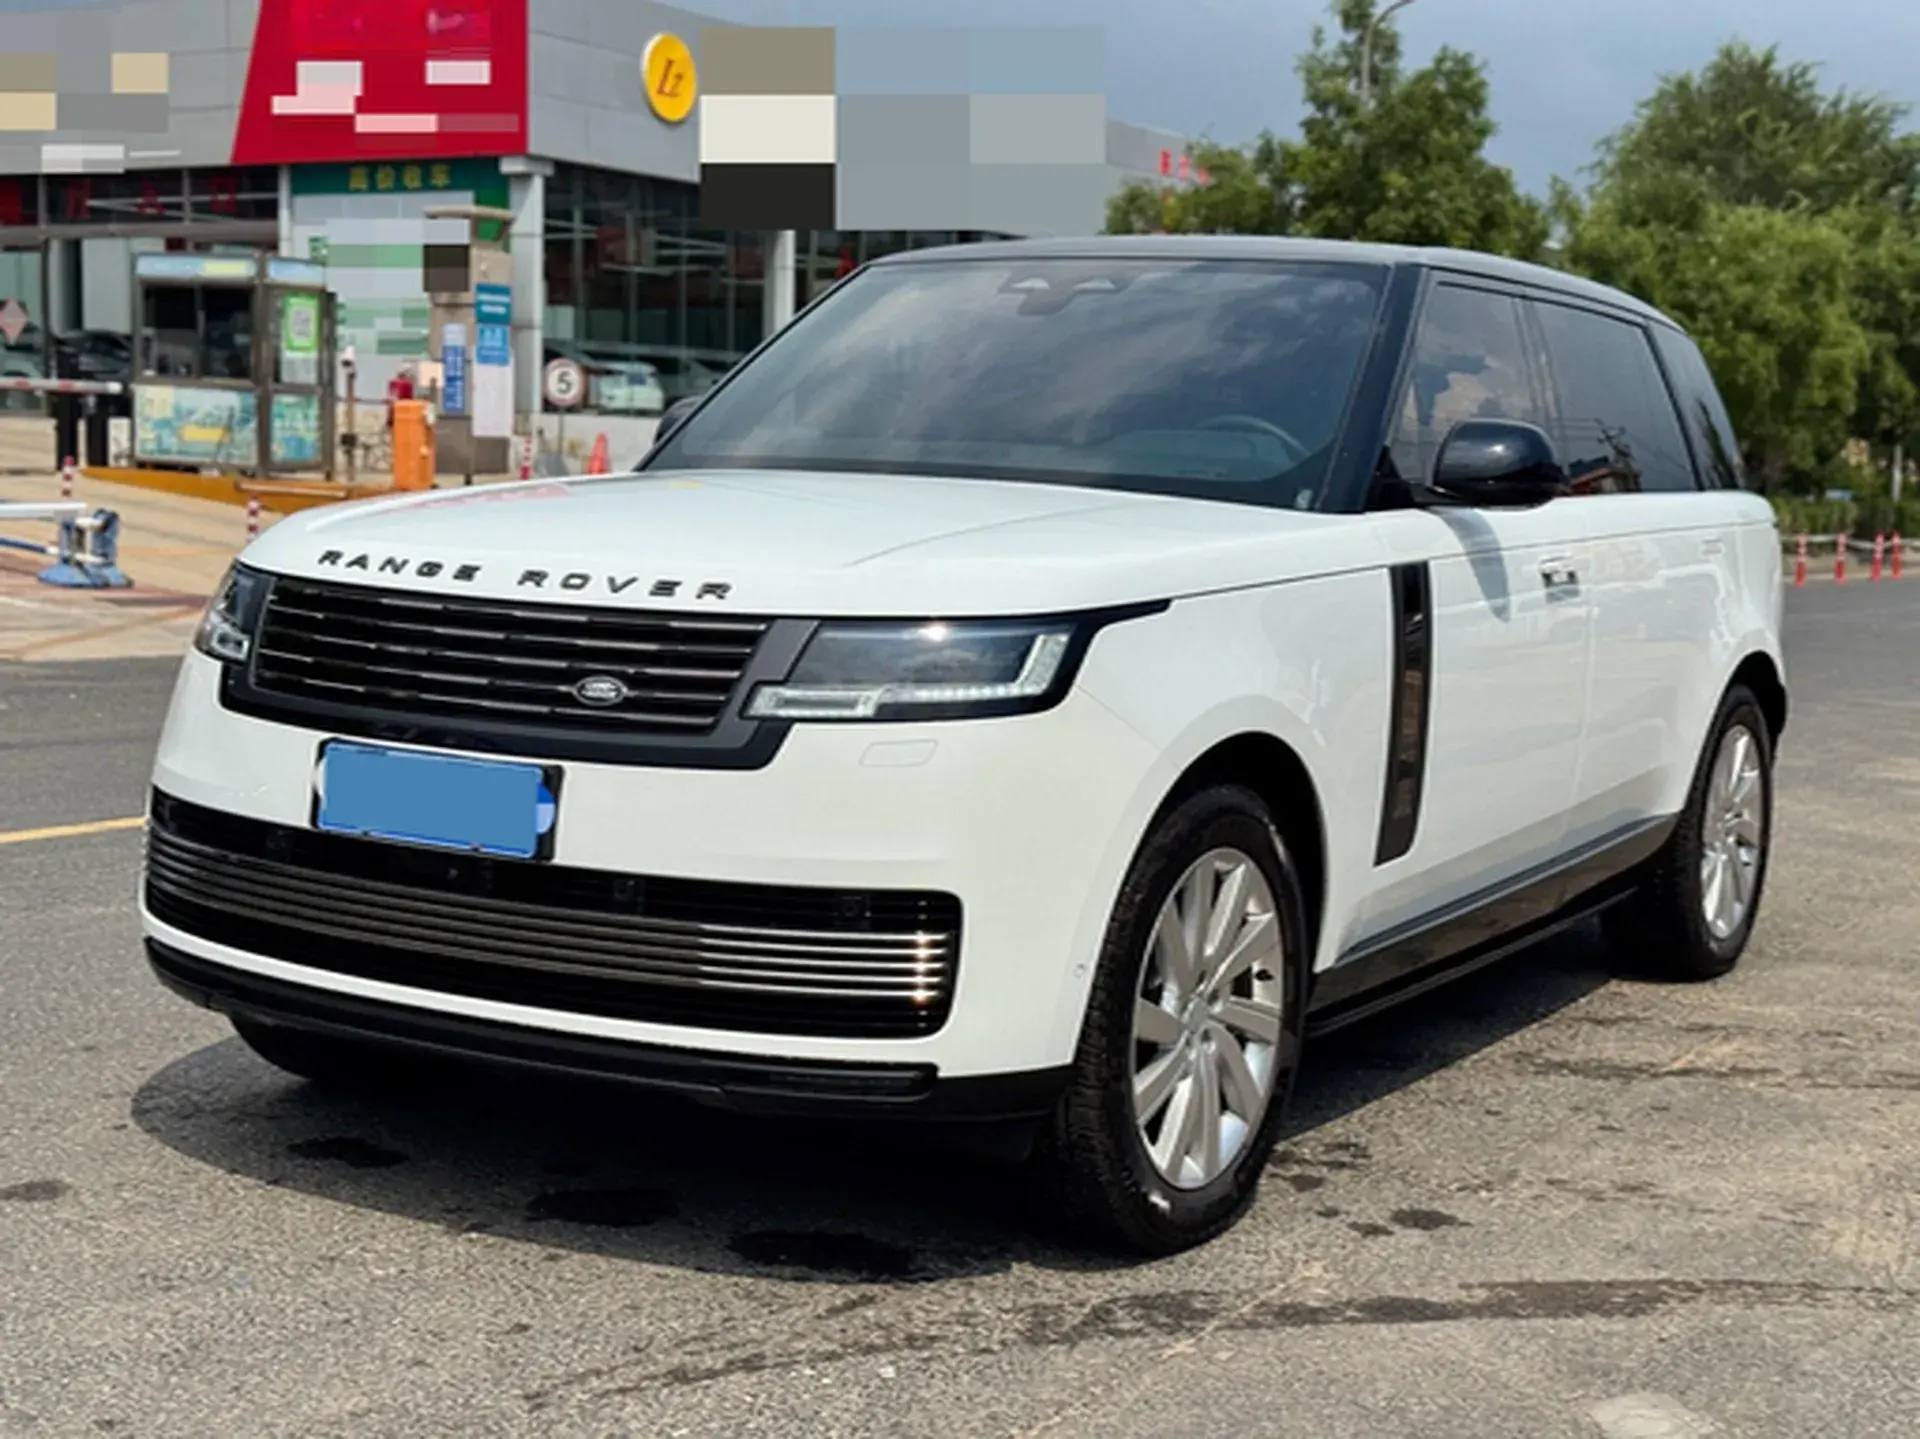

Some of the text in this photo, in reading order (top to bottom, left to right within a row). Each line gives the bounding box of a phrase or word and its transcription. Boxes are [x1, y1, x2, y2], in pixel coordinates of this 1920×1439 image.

[556, 371, 572, 395] 5
[318, 550, 733, 601] RANGE ROVER
